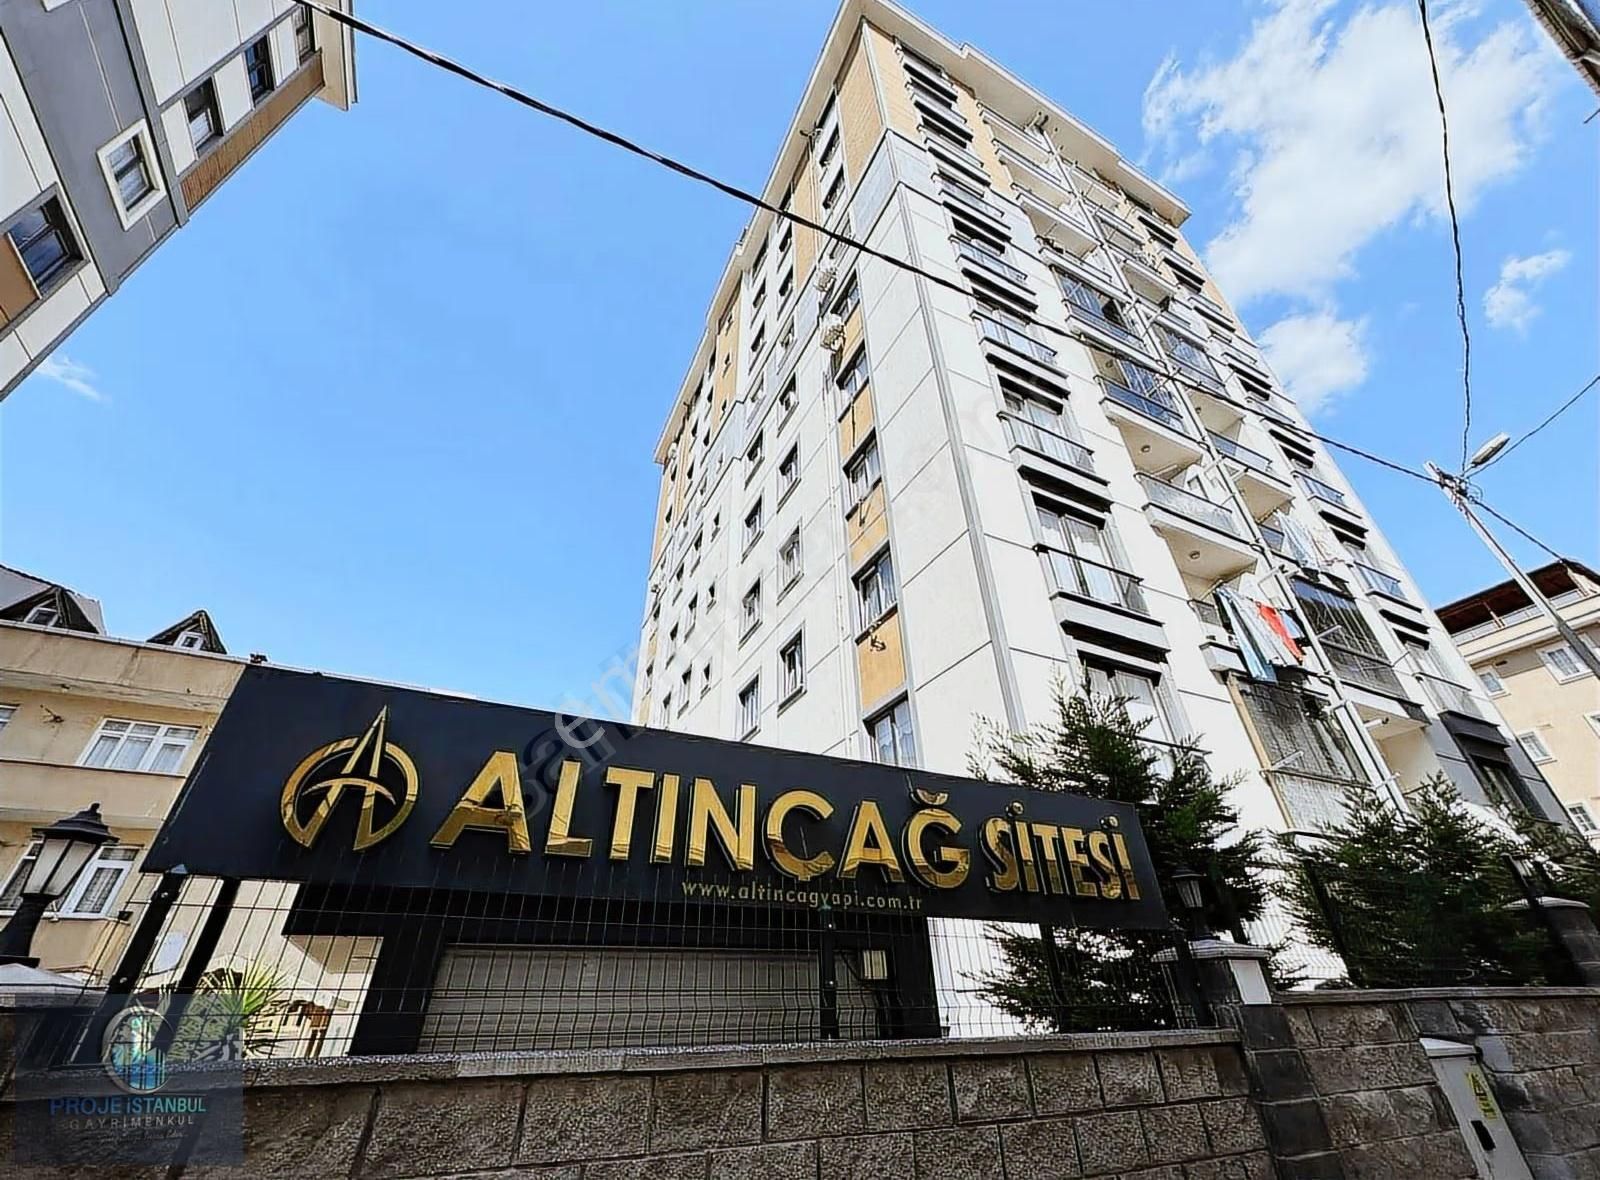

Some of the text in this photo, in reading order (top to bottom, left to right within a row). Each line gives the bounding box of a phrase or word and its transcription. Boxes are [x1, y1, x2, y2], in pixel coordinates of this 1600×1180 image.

[430, 750, 1141, 900] ALTINÇAĞ SİTESİ
[682, 880, 923, 910] www.altincagyapi.com.tr
